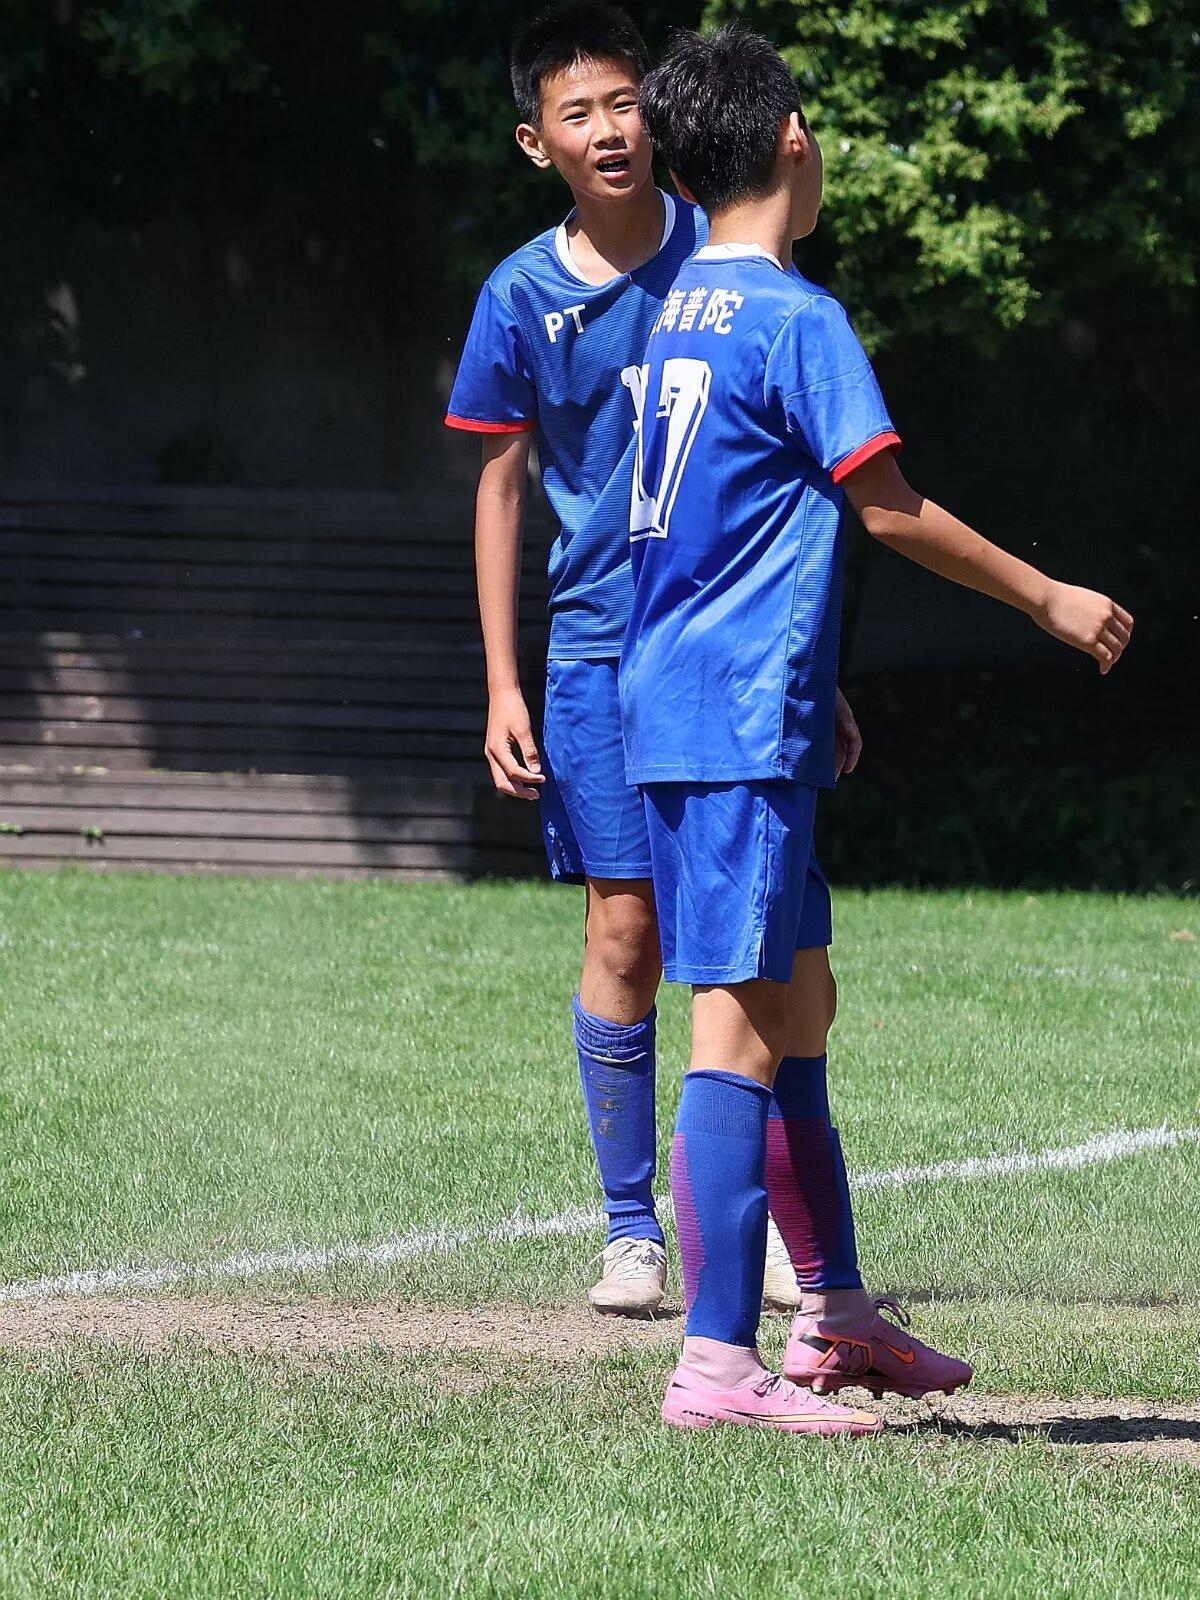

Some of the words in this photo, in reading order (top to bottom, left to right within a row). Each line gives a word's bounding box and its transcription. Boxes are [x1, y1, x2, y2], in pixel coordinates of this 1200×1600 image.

[544, 304, 586, 343] PT
[650, 286, 744, 335] 海普陀
[620, 358, 713, 542] 17
